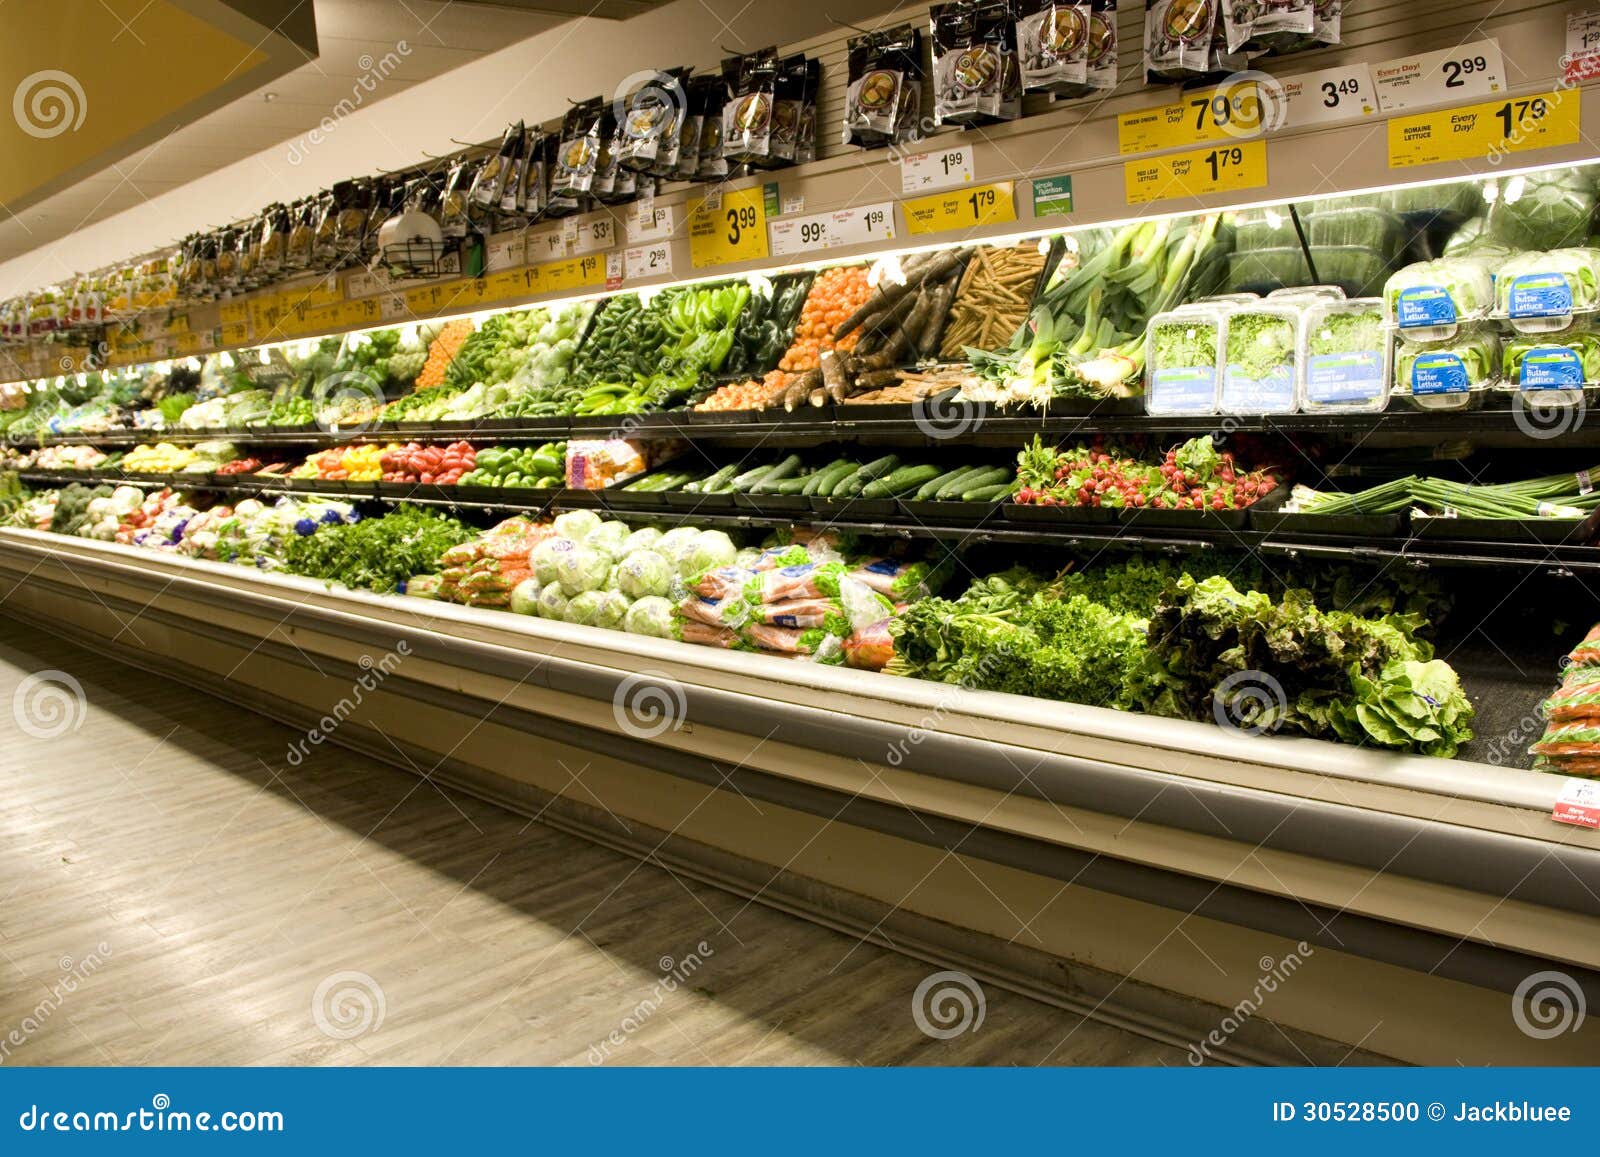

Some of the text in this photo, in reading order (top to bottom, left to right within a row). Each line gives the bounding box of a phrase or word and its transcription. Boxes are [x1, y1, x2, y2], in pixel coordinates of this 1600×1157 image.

[1165, 107, 1185, 115] Every
[1451, 114, 1478, 123] Every
[1403, 125, 1432, 134] ROMAINE
[1453, 122, 1475, 132] Day!
[1404, 132, 1431, 141] LETTUCE
[1172, 160, 1192, 168] Every
[1515, 295, 1538, 303] Butter
[1515, 303, 1543, 311] Lettuce
